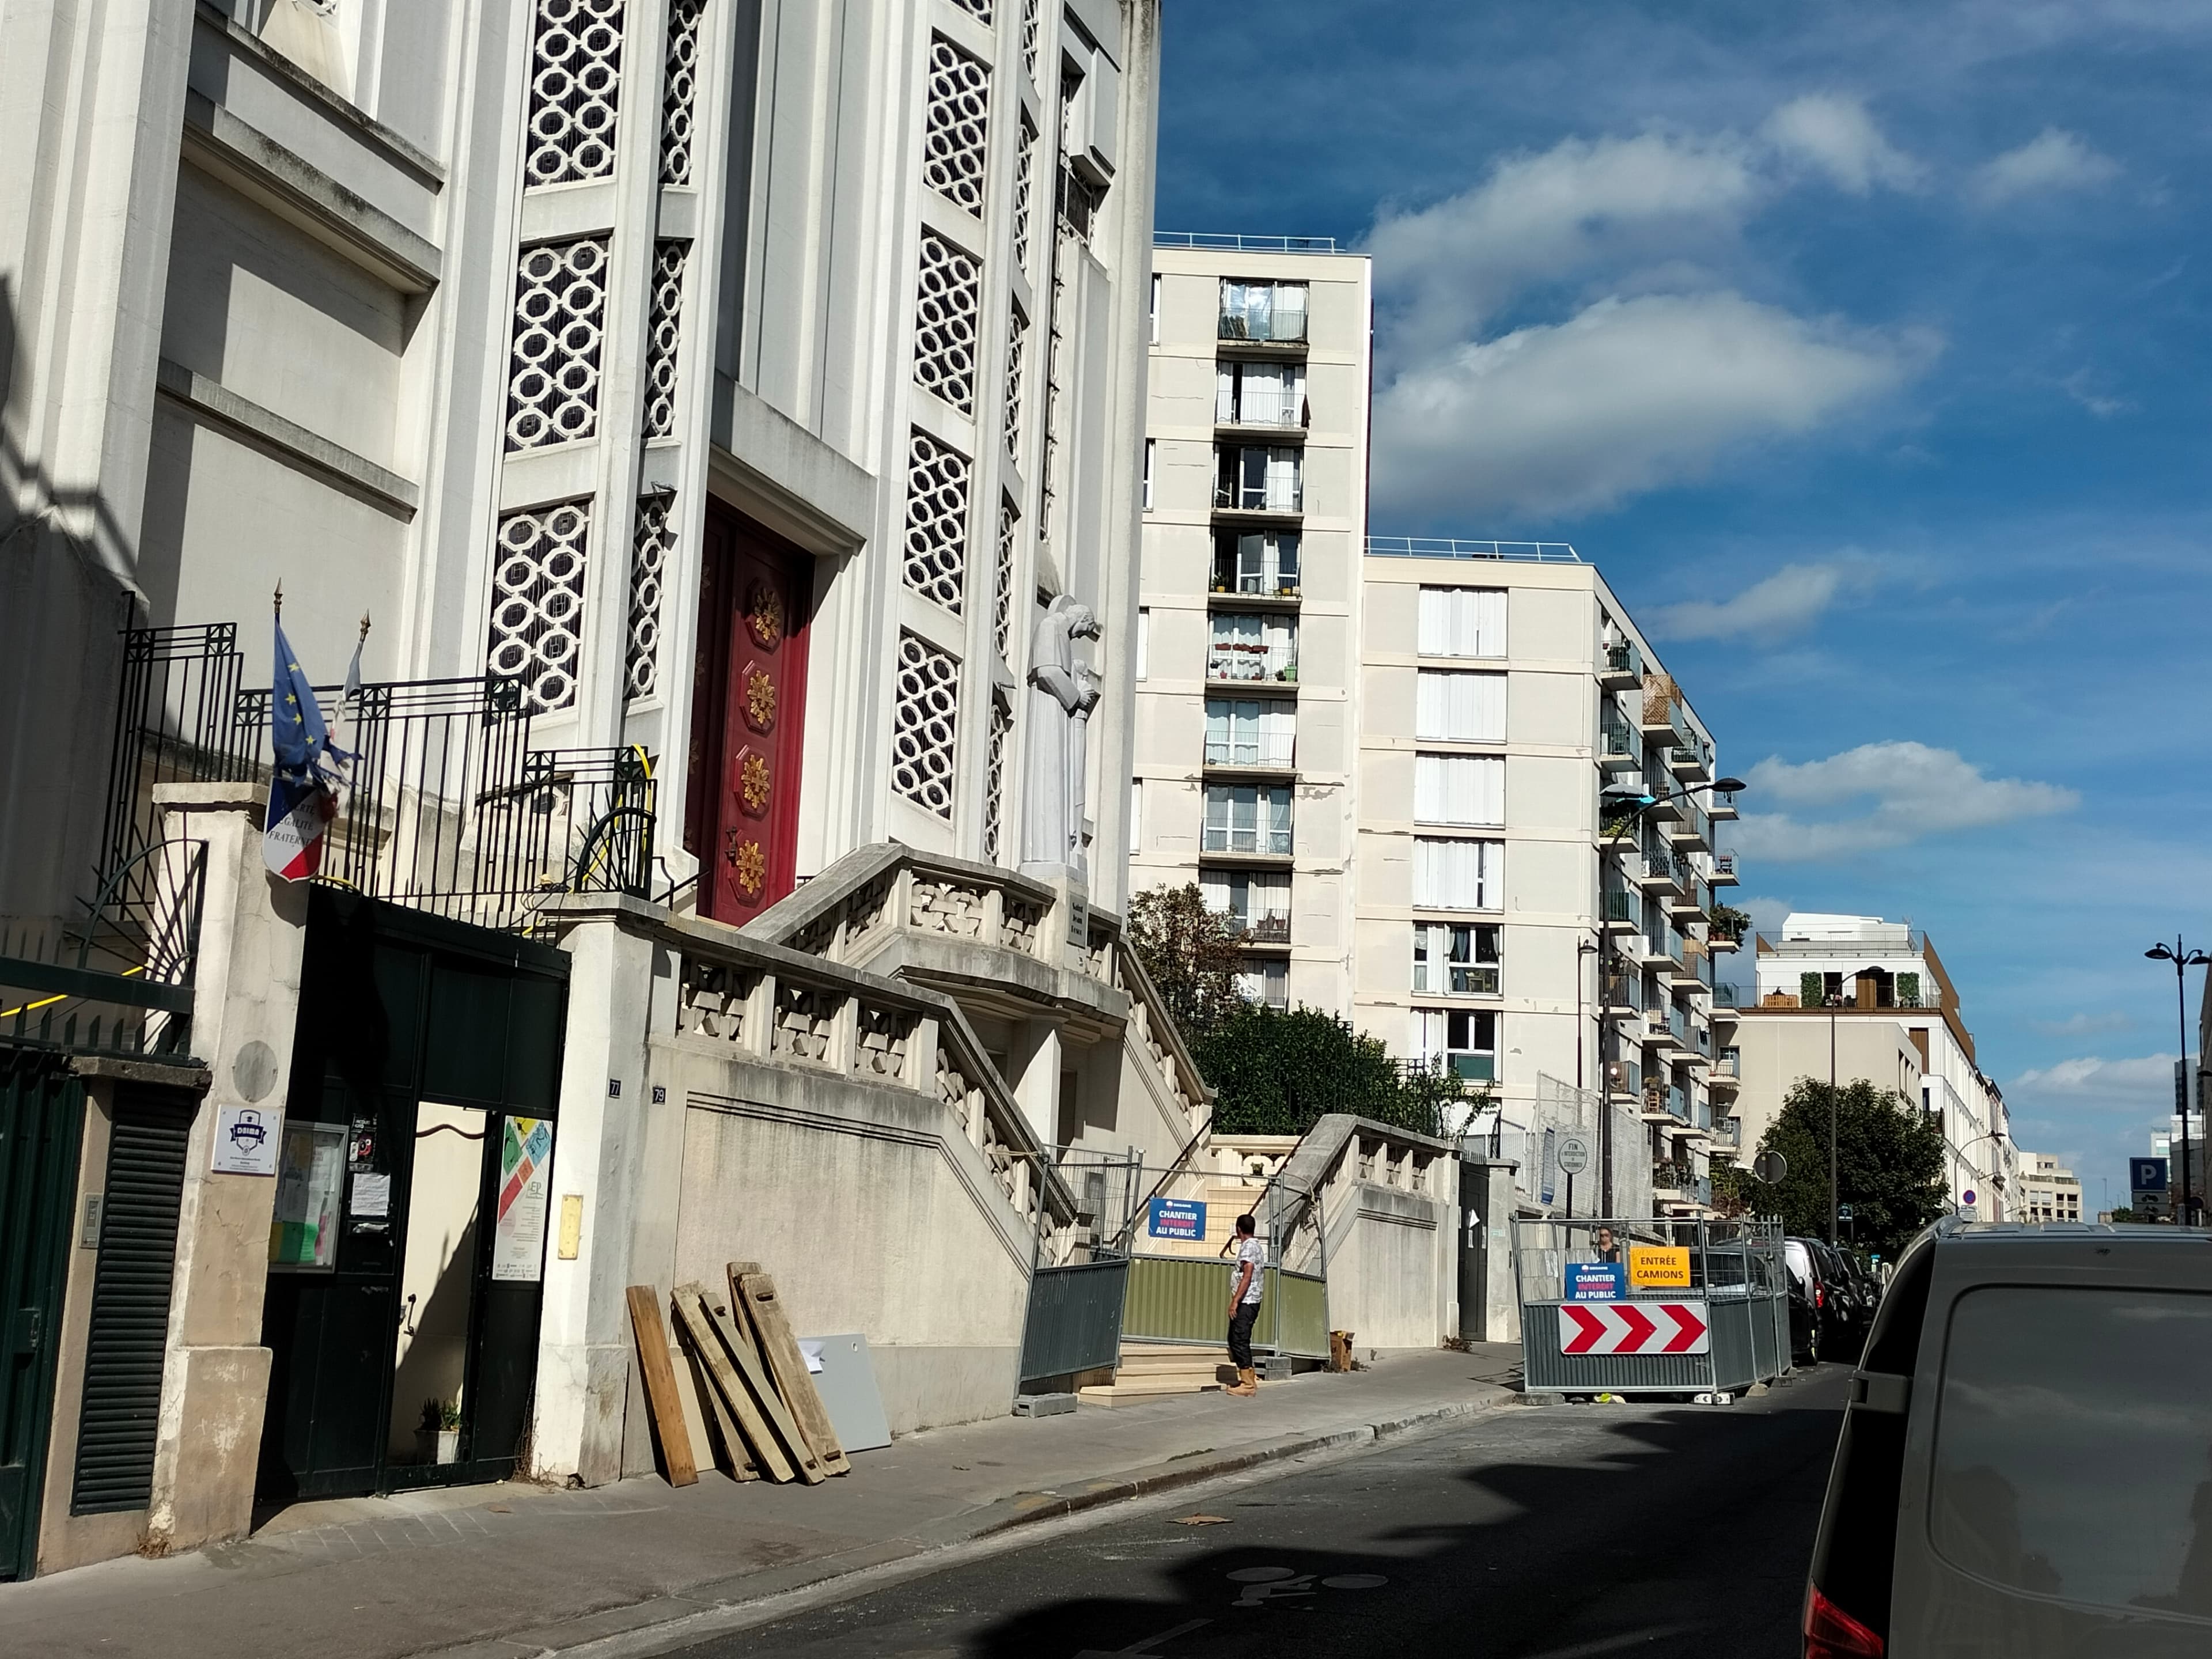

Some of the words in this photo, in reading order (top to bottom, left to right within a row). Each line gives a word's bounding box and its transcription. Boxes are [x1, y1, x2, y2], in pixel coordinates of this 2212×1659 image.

[611, 1082, 619, 1094] 77
[654, 1089, 664, 1101] 79
[2141, 1164, 2157, 1185] P
[1159, 1210, 1197, 1220] CHANTIER
[1160, 1218, 1195, 1228] INTERDIT
[1156, 1226, 1167, 1234] AU
[1169, 1228, 1196, 1237] PUBLIC
[1641, 1255, 1676, 1266] ENTRÉE
[1575, 1274, 1615, 1282] CHANTIER
[1637, 1270, 1684, 1279] CAMIONS
